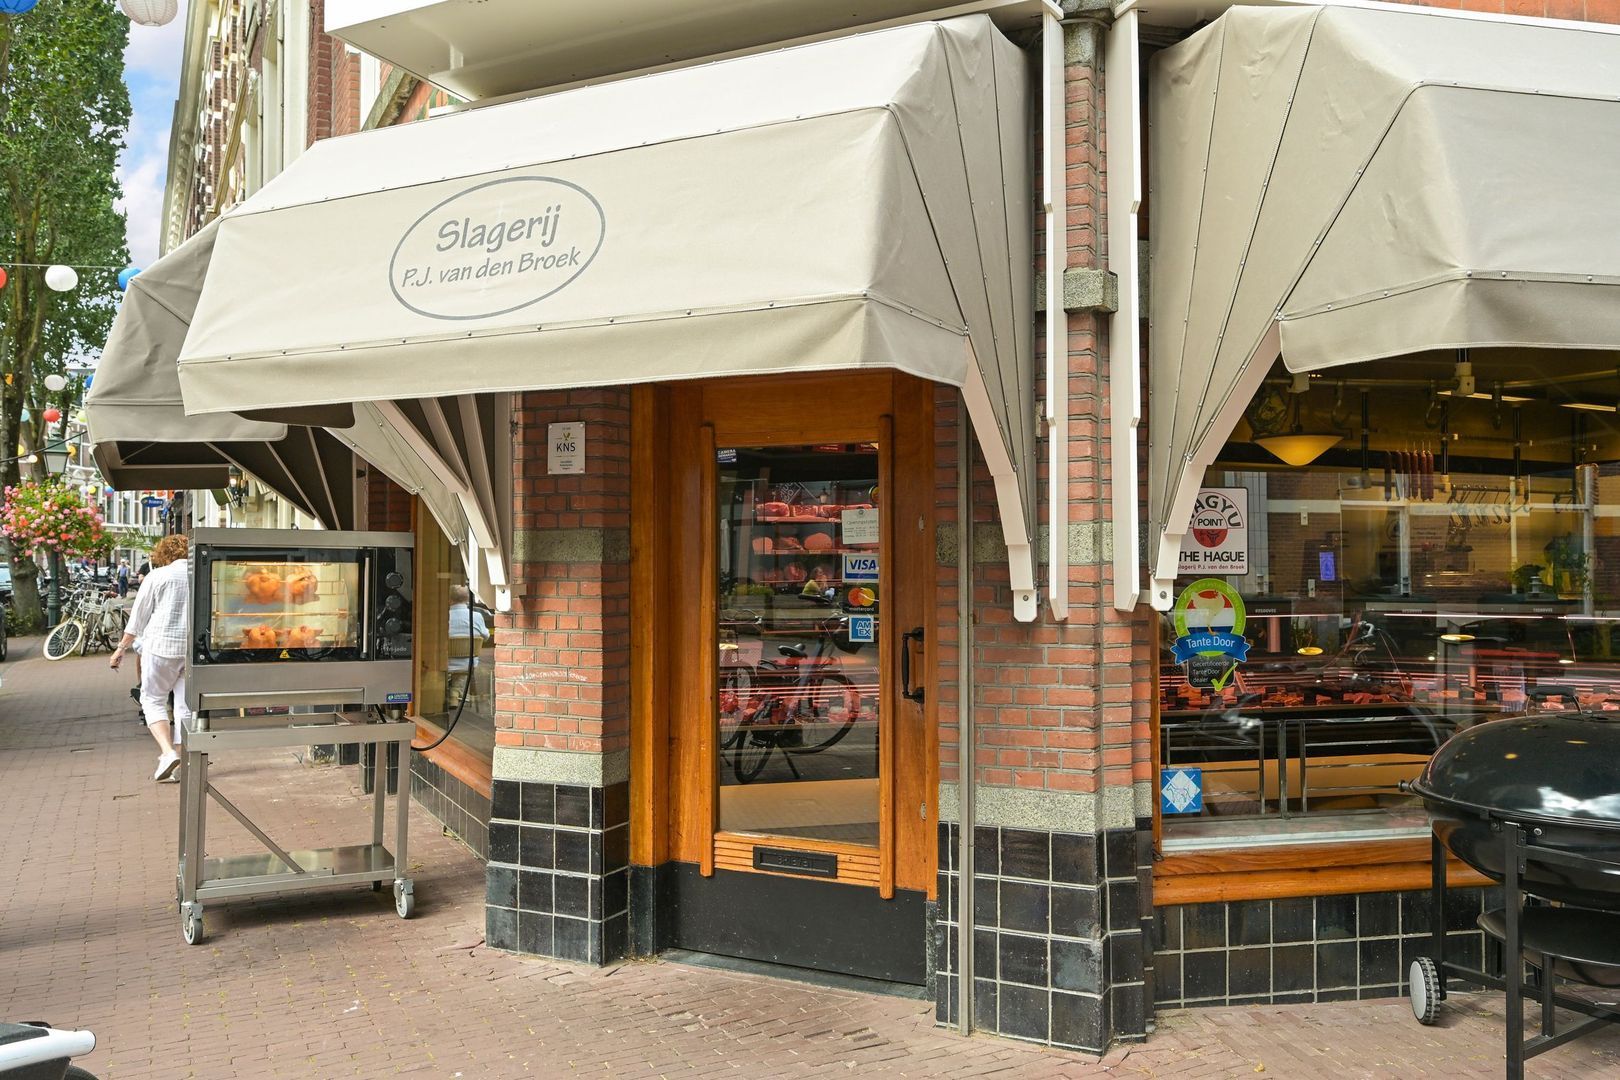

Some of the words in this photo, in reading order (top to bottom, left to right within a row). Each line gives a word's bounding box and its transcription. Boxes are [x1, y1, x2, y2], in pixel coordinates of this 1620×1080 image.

[436, 204, 561, 253] Slagerij
[402, 266, 433, 287] P.J.
[439, 266, 472, 283] van
[475, 257, 514, 279] den
[518, 246, 581, 273] Broek
[556, 442, 576, 452] KNS
[1189, 495, 1241, 527] AGYU
[1197, 518, 1223, 526] POINT
[1179, 551, 1200, 562] THE
[1204, 551, 1245, 562] HAGUE
[849, 559, 876, 570] VISA
[856, 621, 872, 629] AM
[858, 628, 872, 637] EX
[1186, 637, 1213, 648] Tante
[1213, 636, 1236, 648] Door
